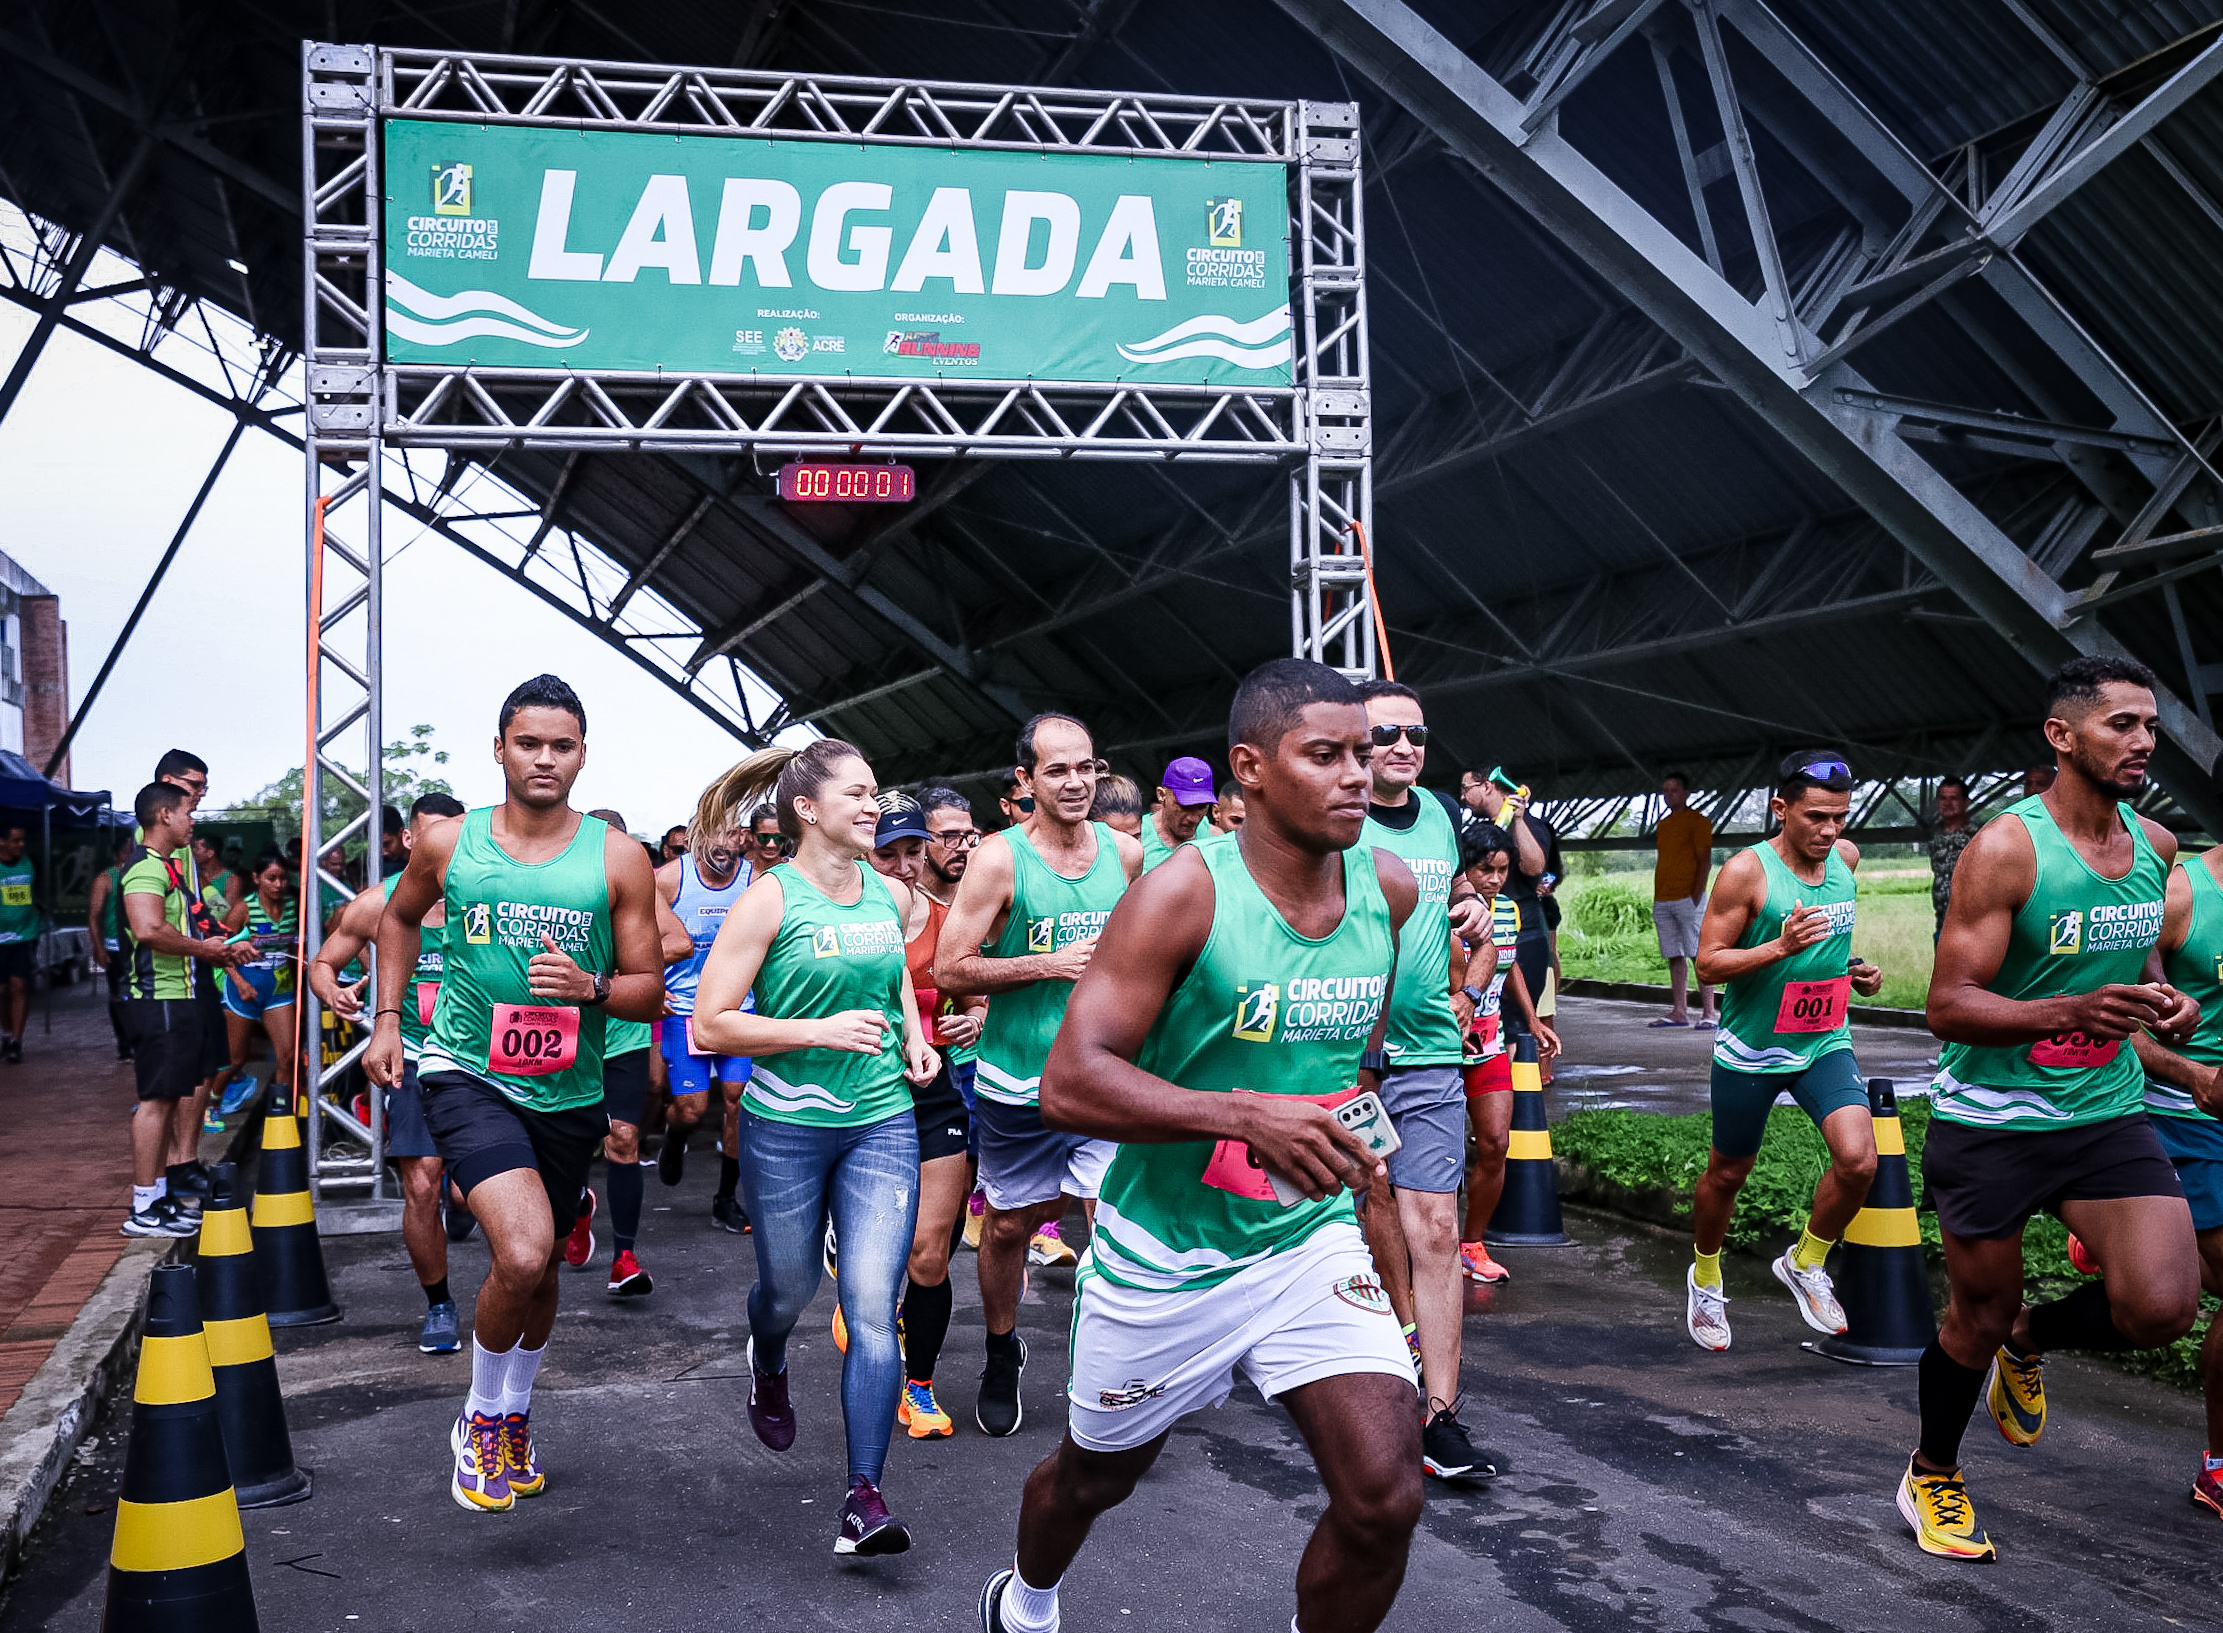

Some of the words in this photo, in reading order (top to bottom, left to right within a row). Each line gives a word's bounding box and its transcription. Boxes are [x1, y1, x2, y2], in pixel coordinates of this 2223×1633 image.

[407, 216, 486, 233] CIRCUITO
[407, 231, 498, 249] CORRIDAS
[527, 168, 1167, 300] LARGADA
[407, 247, 455, 258] MARIETA
[458, 249, 498, 260] CAMELI
[1186, 248, 1254, 263] CIRCUITO
[1186, 262, 1265, 278] CORRIDAS
[1186, 277, 1228, 287] MARIETA
[1231, 278, 1265, 288] CAMELI
[757, 308, 820, 320] REALIZAÇÃO:
[894, 313, 965, 324] ORGANIZAÇÃO:
[736, 330, 763, 343] SEE
[812, 340, 845, 352] ACRE
[898, 342, 980, 357] RUNNING
[931, 358, 978, 366] EVENTOS
[496, 901, 581, 925] CIRCUITO
[2089, 901, 2158, 922] CIRCUITO
[496, 918, 590, 942] CORRIDAS
[845, 945, 886, 956] MARIETA
[2086, 939, 2132, 953] MARIETA
[1287, 976, 1380, 1001] CIRCUITO
[1793, 996, 1833, 1018] 001
[1281, 1027, 1341, 1043] MARIETA
[502, 1029, 562, 1058] 002
